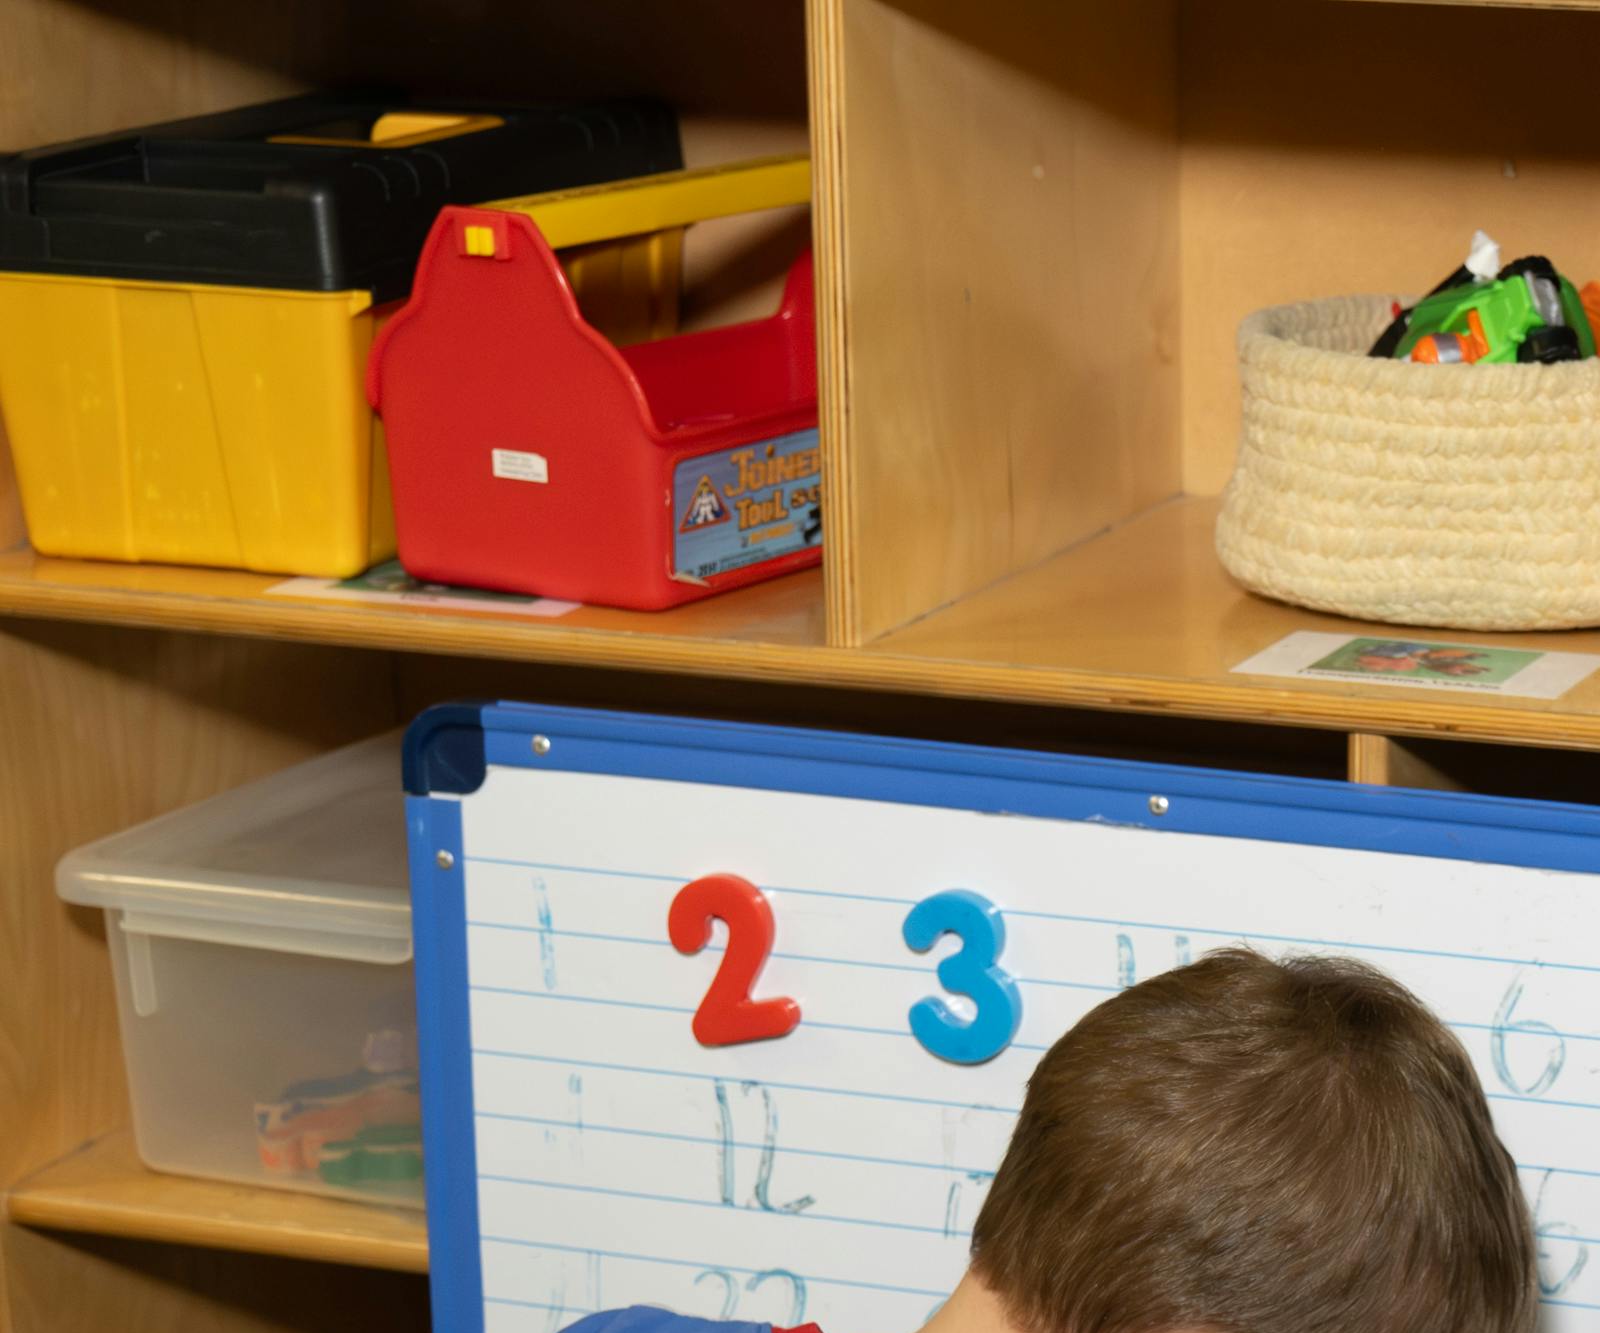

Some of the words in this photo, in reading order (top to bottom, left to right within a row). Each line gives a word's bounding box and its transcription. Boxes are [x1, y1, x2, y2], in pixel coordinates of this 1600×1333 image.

[668, 872, 801, 1047] 2
[902, 888, 1024, 1065] 3
[1491, 965, 1566, 1097] 6
